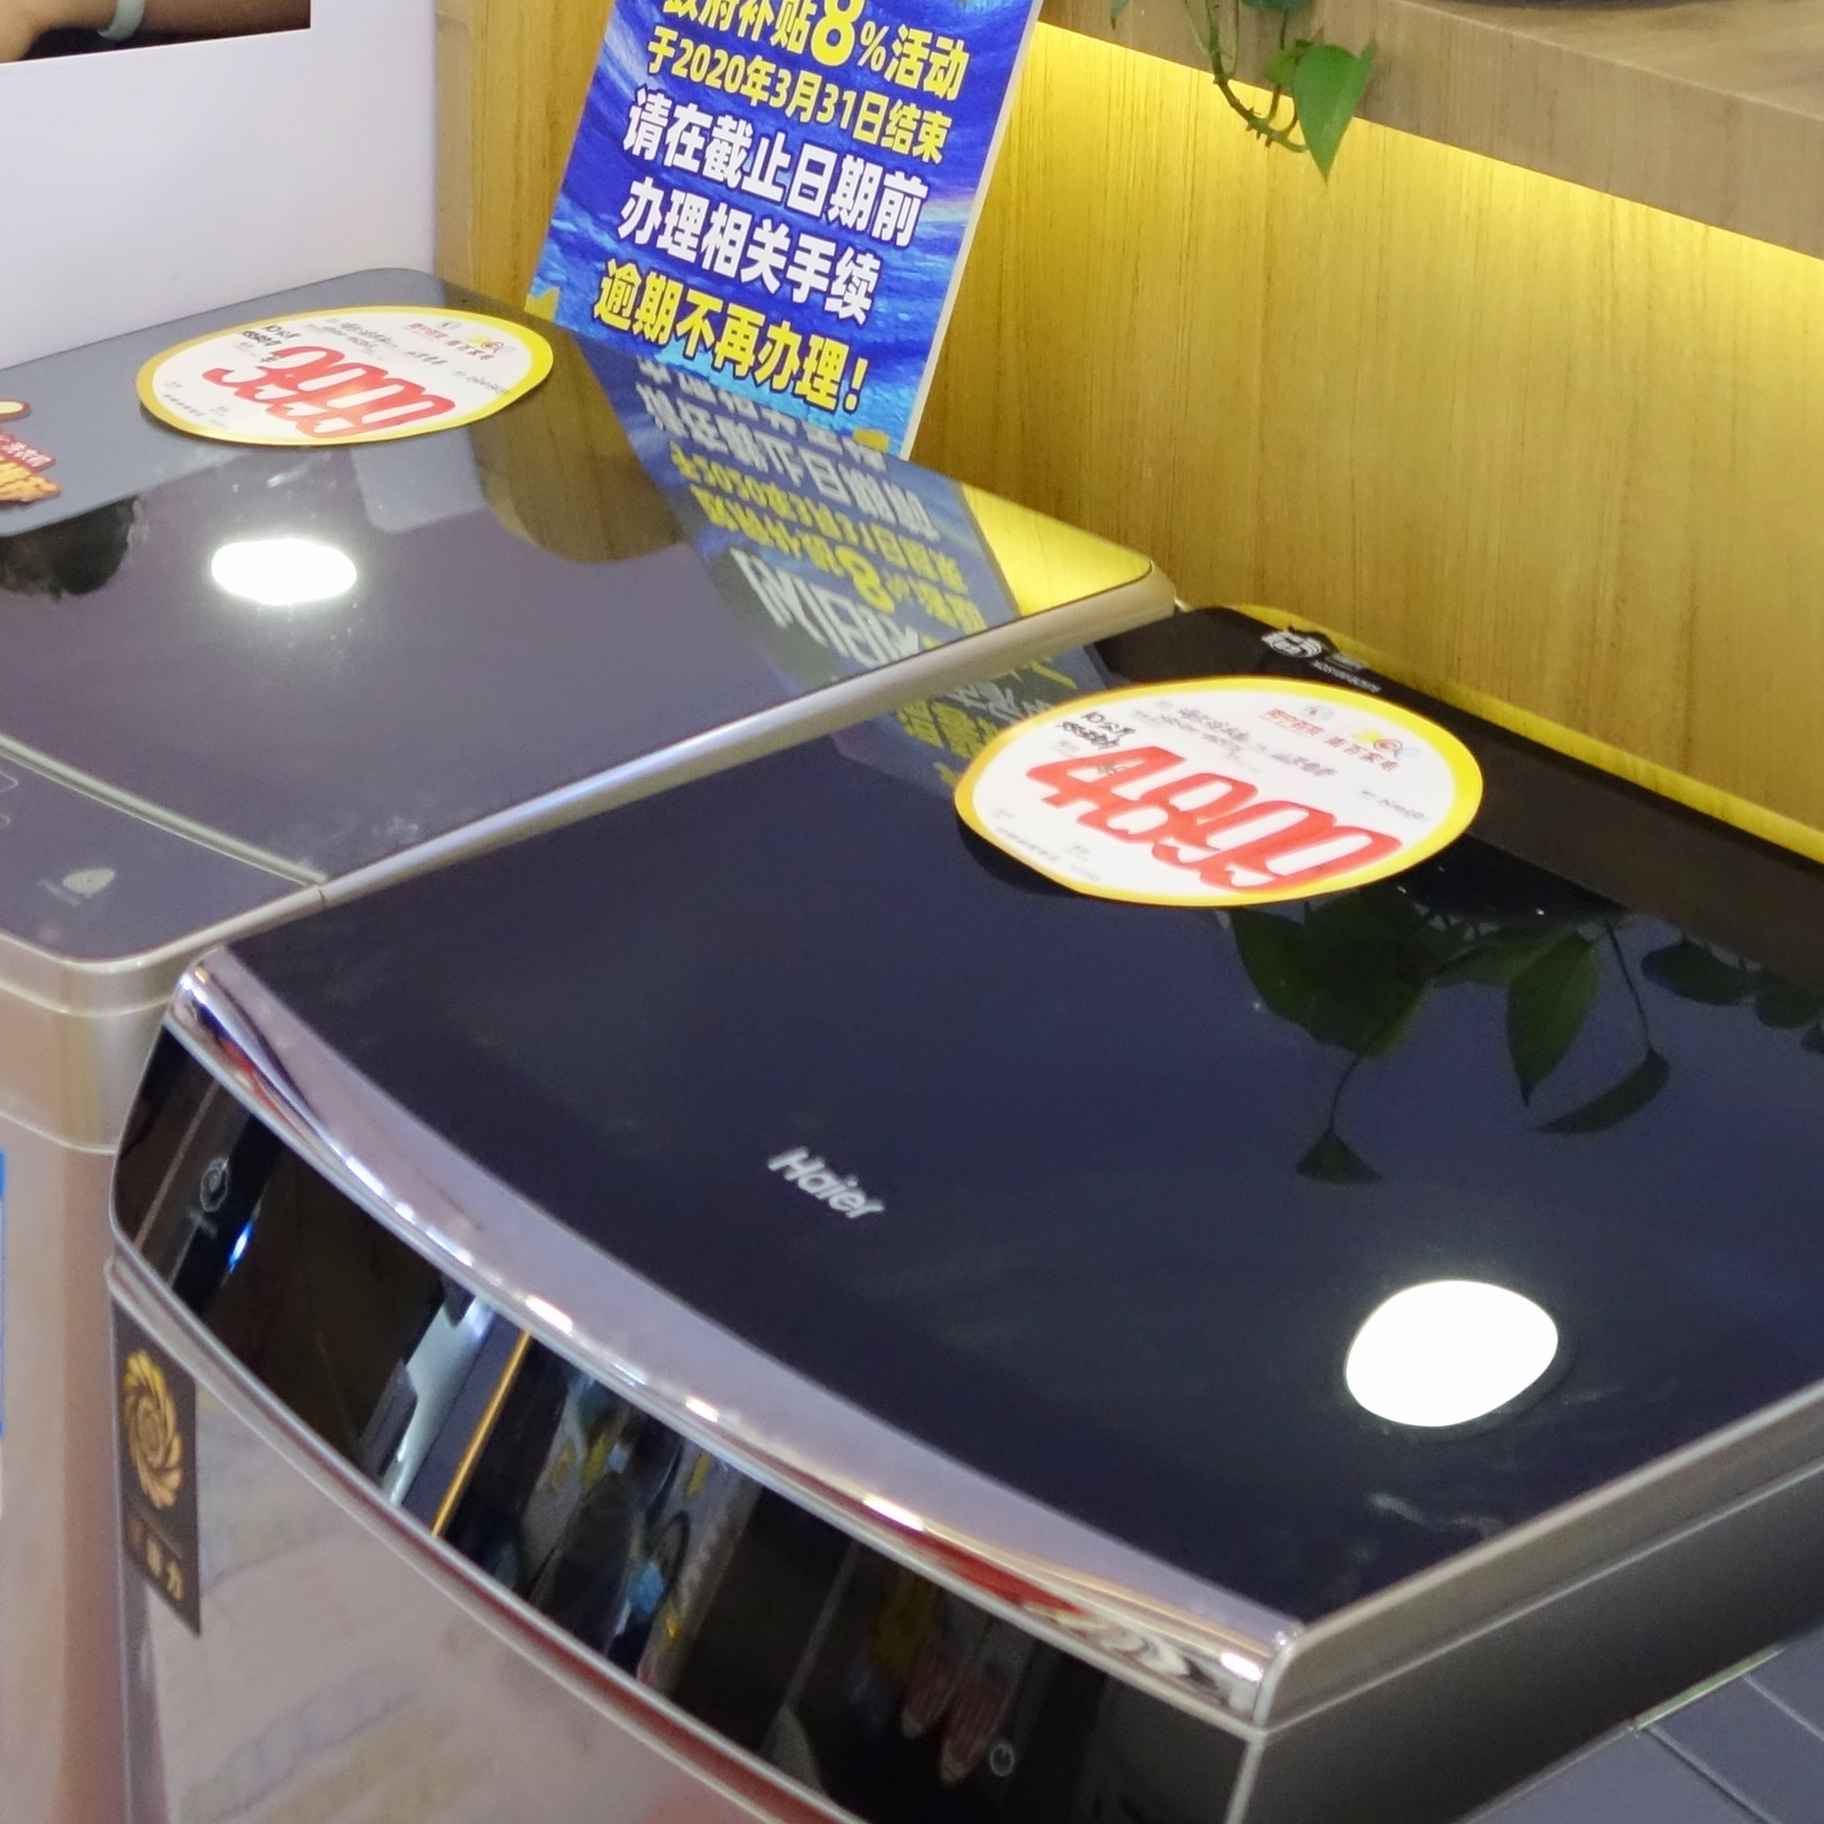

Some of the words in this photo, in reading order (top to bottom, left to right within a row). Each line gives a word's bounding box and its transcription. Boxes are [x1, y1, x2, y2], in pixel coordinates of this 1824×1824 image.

[647, 25, 954, 164] 于2020年3月31日结束
[622, 86, 931, 249] 请在截止日期前
[617, 177, 882, 326] 办理相关手续
[768, 1145, 887, 1220] Haier
